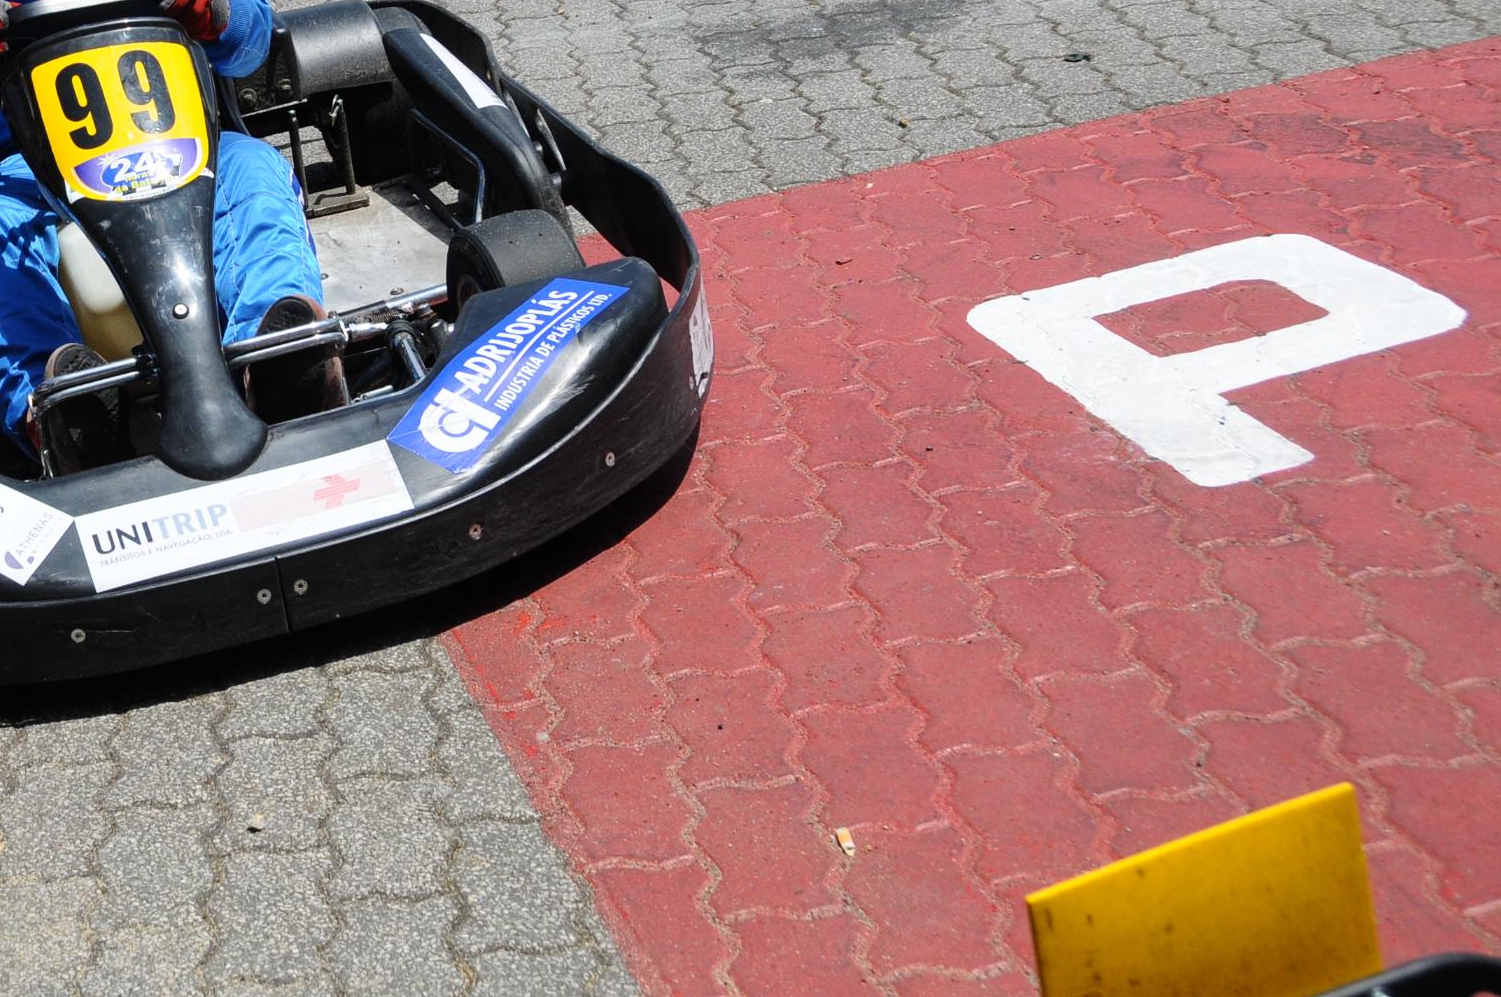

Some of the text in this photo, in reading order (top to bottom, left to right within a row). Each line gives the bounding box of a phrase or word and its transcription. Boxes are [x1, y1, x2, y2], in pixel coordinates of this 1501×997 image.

[55, 49, 176, 150] 99
[454, 290, 578, 394] ADRIJOPLÁS
[494, 293, 613, 412] INDUSTRIA DE PLÁSTICOS LTD.
[966, 233, 1468, 488] P
[17, 510, 54, 556] ATHENAS
[92, 503, 227, 555] UNITRIP
[100, 550, 147, 567] TRÂNSITOS
